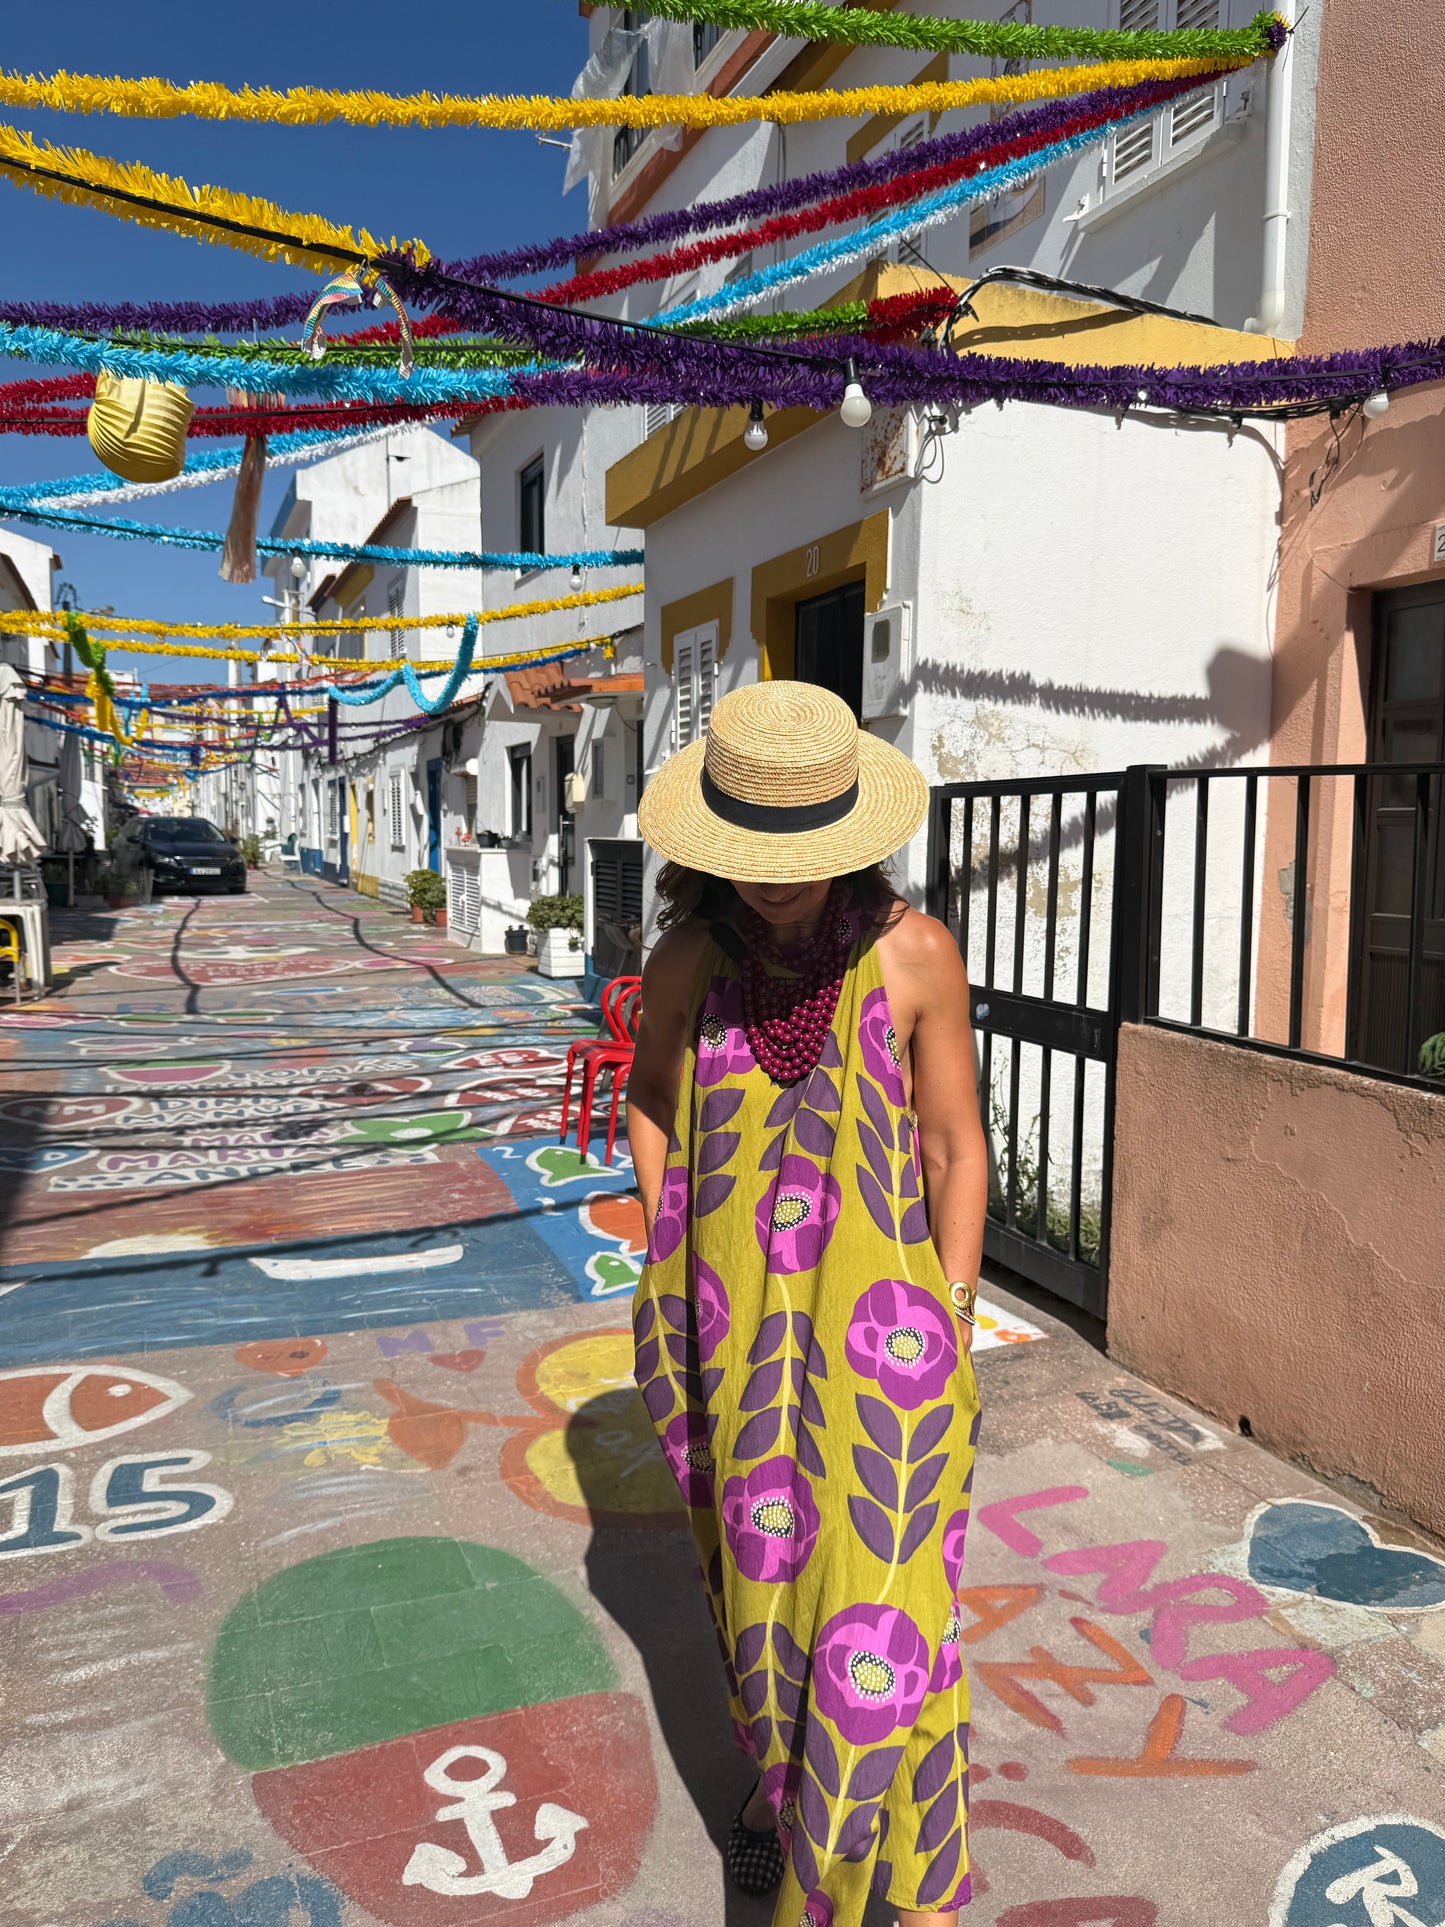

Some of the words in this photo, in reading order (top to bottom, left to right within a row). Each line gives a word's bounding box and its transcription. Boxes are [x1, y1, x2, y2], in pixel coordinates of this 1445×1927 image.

[806, 545, 820, 578] 20
[97, 1144, 339, 1172] MARTA
[0, 1448, 234, 1559] 15
[977, 1486, 1338, 1736] LARA
